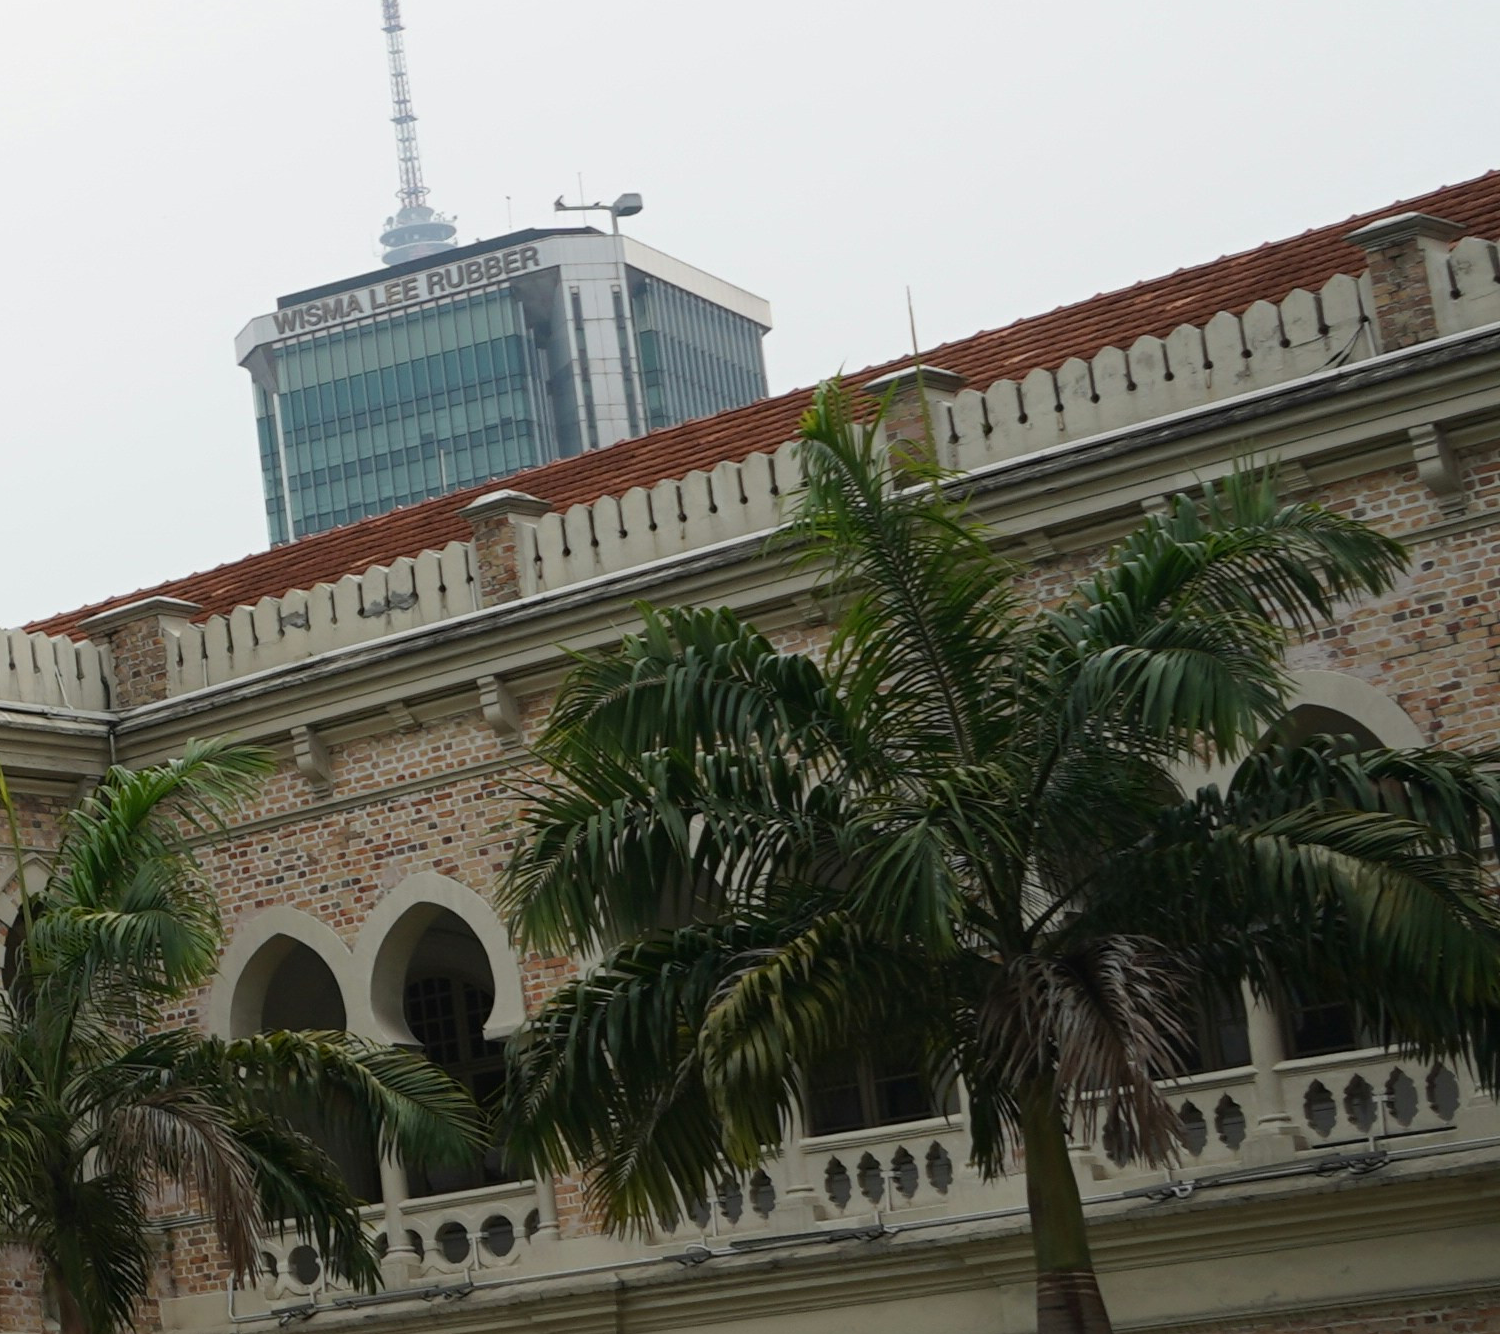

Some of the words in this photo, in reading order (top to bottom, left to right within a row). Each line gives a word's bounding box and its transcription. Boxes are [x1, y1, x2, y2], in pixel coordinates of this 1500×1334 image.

[272, 294, 365, 335] WISMA
[369, 277, 420, 311] LEE
[426, 246, 541, 295] RUBBER
